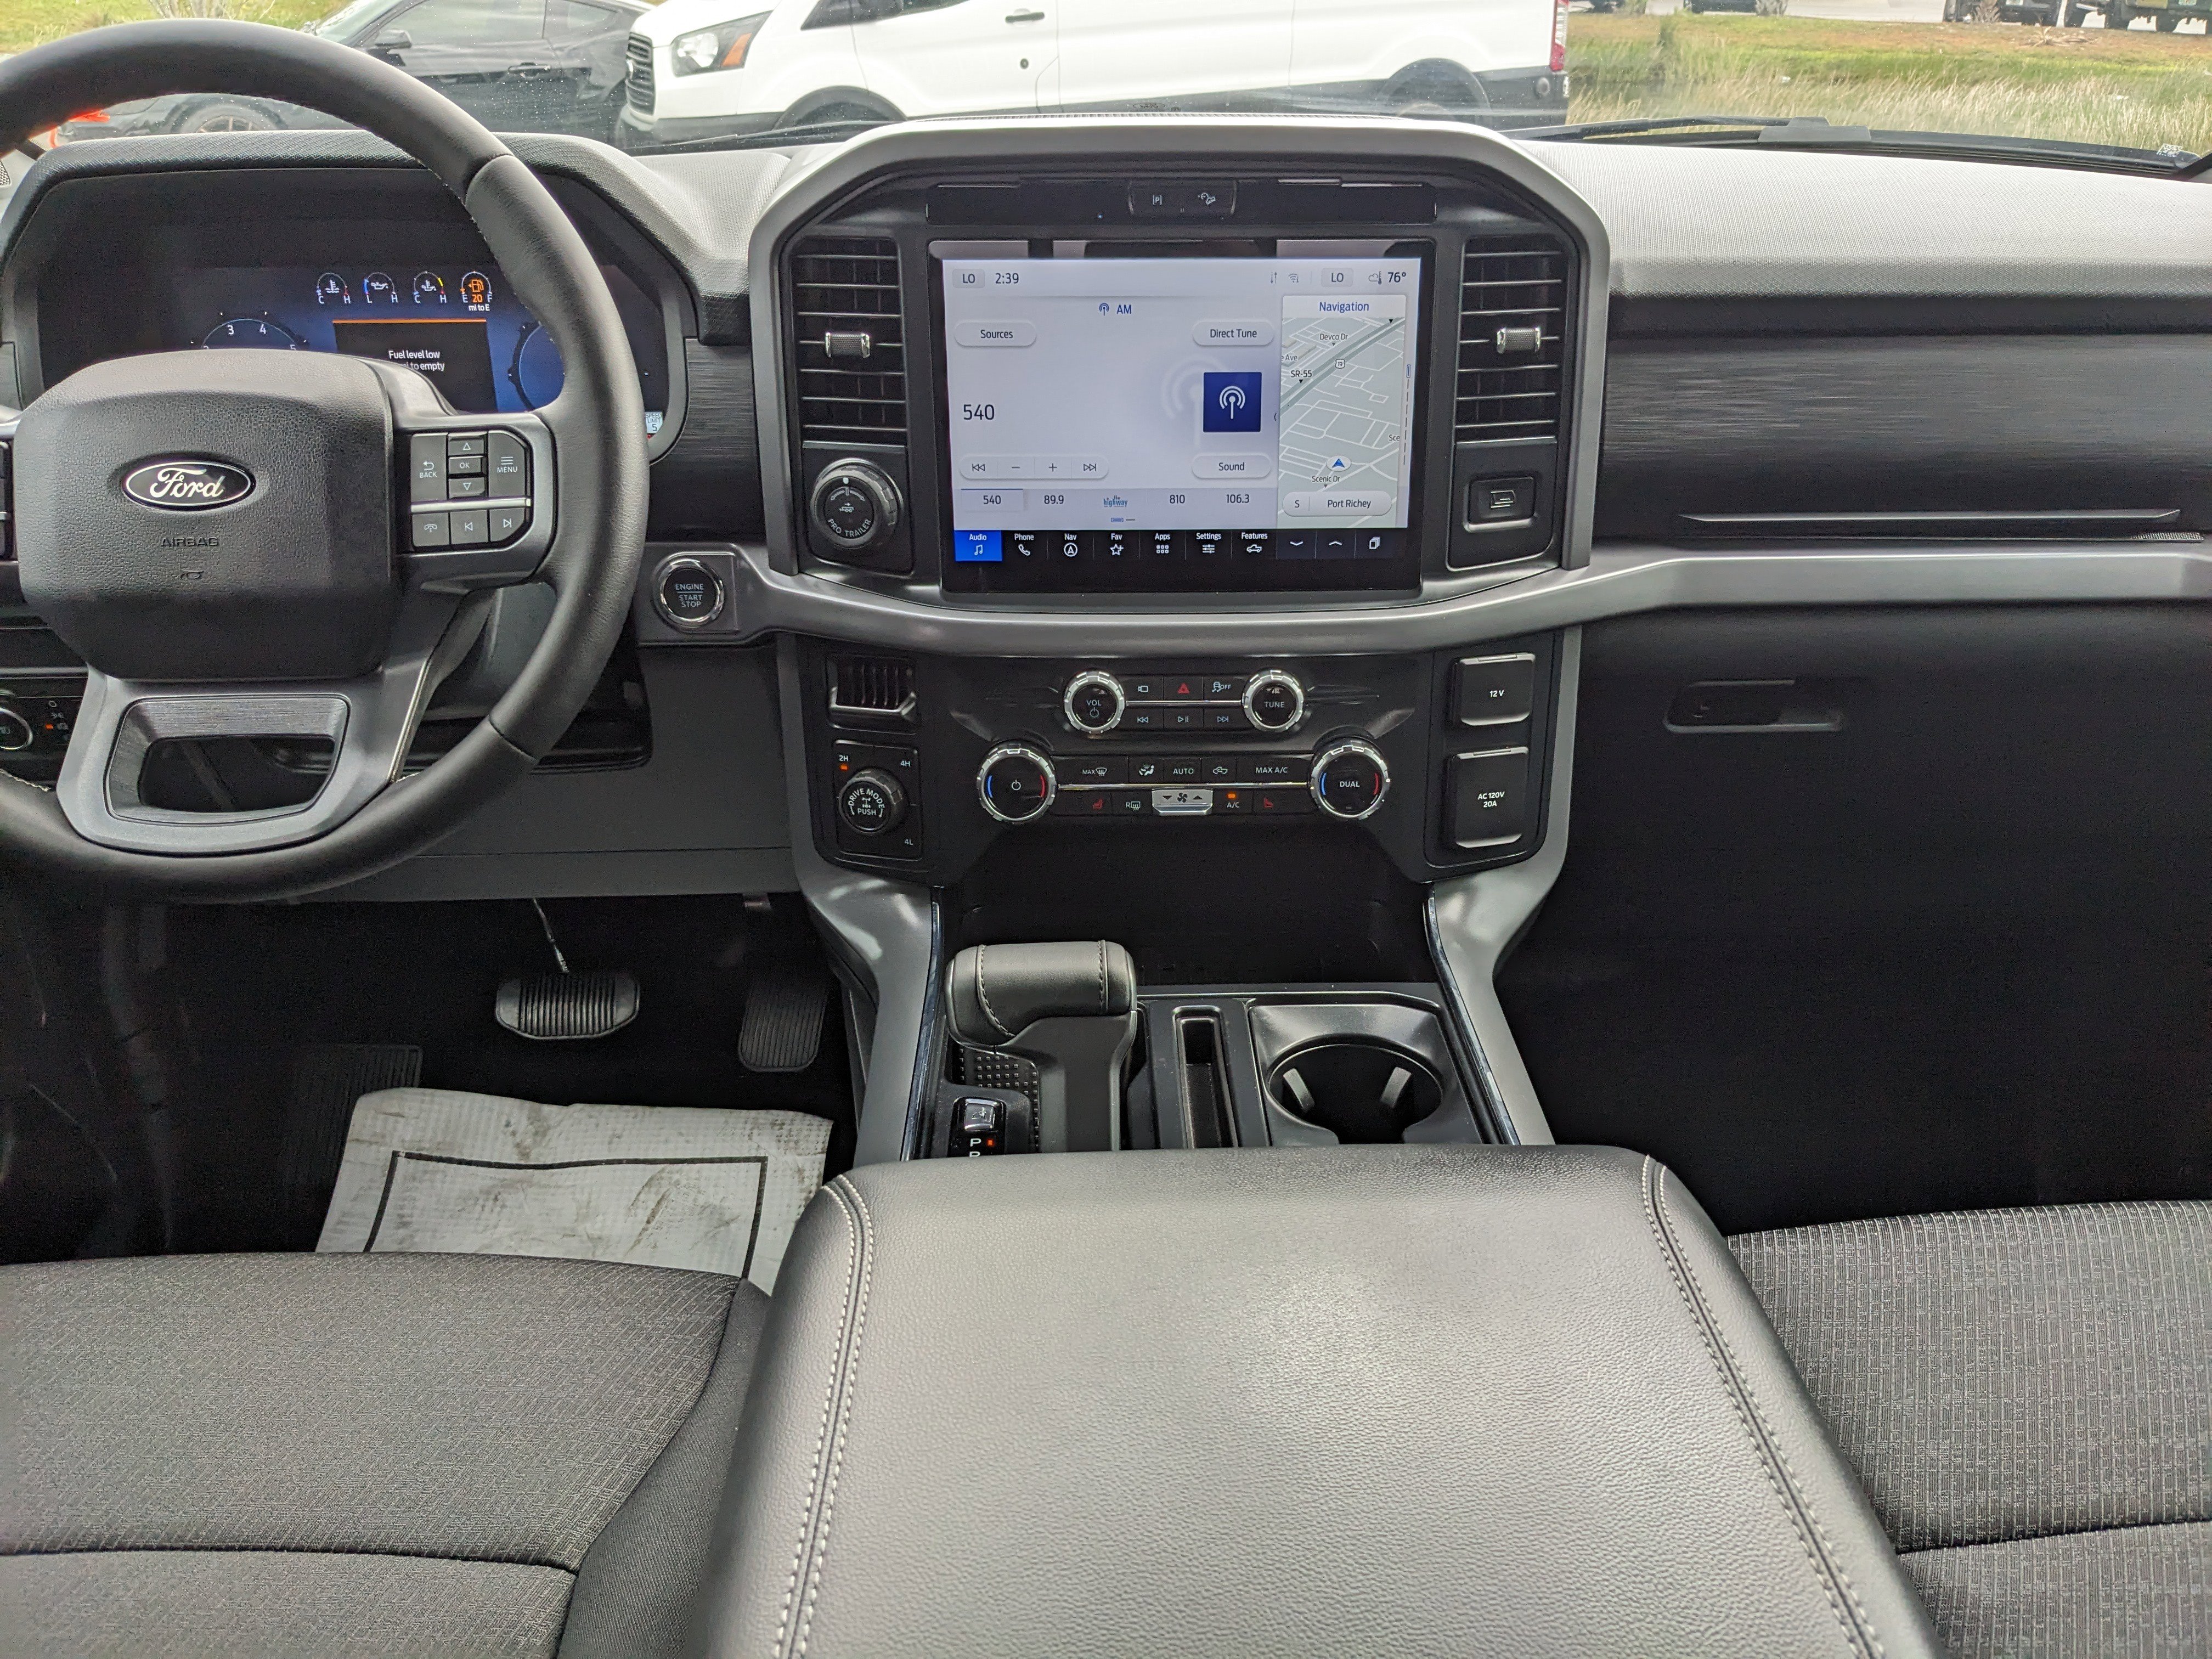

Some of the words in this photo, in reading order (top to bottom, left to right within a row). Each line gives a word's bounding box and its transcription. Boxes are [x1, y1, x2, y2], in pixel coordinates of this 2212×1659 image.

[962, 273, 975, 284] LO
[995, 273, 1019, 284] 2:39
[1331, 273, 1344, 283] LO
[1387, 272, 1407, 284] 76°
[318, 295, 325, 304] C
[343, 295, 351, 304] H
[366, 295, 373, 303] L
[391, 295, 398, 303] H
[414, 295, 421, 303] C
[439, 295, 447, 303] H
[461, 294, 469, 303] E
[472, 294, 483, 303] 20
[487, 294, 493, 303] F
[1116, 304, 1132, 314] AM
[1319, 302, 1369, 313] Navigation
[227, 324, 235, 336] 3
[259, 324, 267, 335] 4
[980, 330, 1013, 338] Sources
[1210, 329, 1234, 338] Direct
[1237, 329, 1257, 338] Tune
[388, 349, 406, 359] Fuel
[406, 349, 425, 359] level
[425, 349, 441, 359] low
[410, 362, 420, 370] to
[420, 362, 445, 372] empty
[963, 404, 995, 420] 540
[496, 466, 518, 474] MENU
[1218, 462, 1245, 471] Sound
[419, 470, 437, 479] BACK
[150, 465, 224, 500] Ford
[983, 495, 1001, 505] 540
[1044, 495, 1064, 505] 89.9
[1103, 498, 1128, 507] highway
[1170, 494, 1186, 504] 810
[1226, 494, 1250, 504] 106.3
[1294, 500, 1300, 508] S
[1327, 499, 1344, 508] Port
[1346, 499, 1372, 511] Richey
[827, 518, 842, 535] PRO
[844, 518, 871, 538] TRAILER
[1154, 533, 1171, 541] Apps
[1196, 532, 1222, 541] Settings
[161, 537, 219, 548] AIRBAG
[1274, 766, 1289, 774] A/C
[848, 788, 865, 806] DRIVE
[866, 788, 885, 809] MODE
[1488, 791, 1505, 799] 120V
[969, 1138, 982, 1147] P
